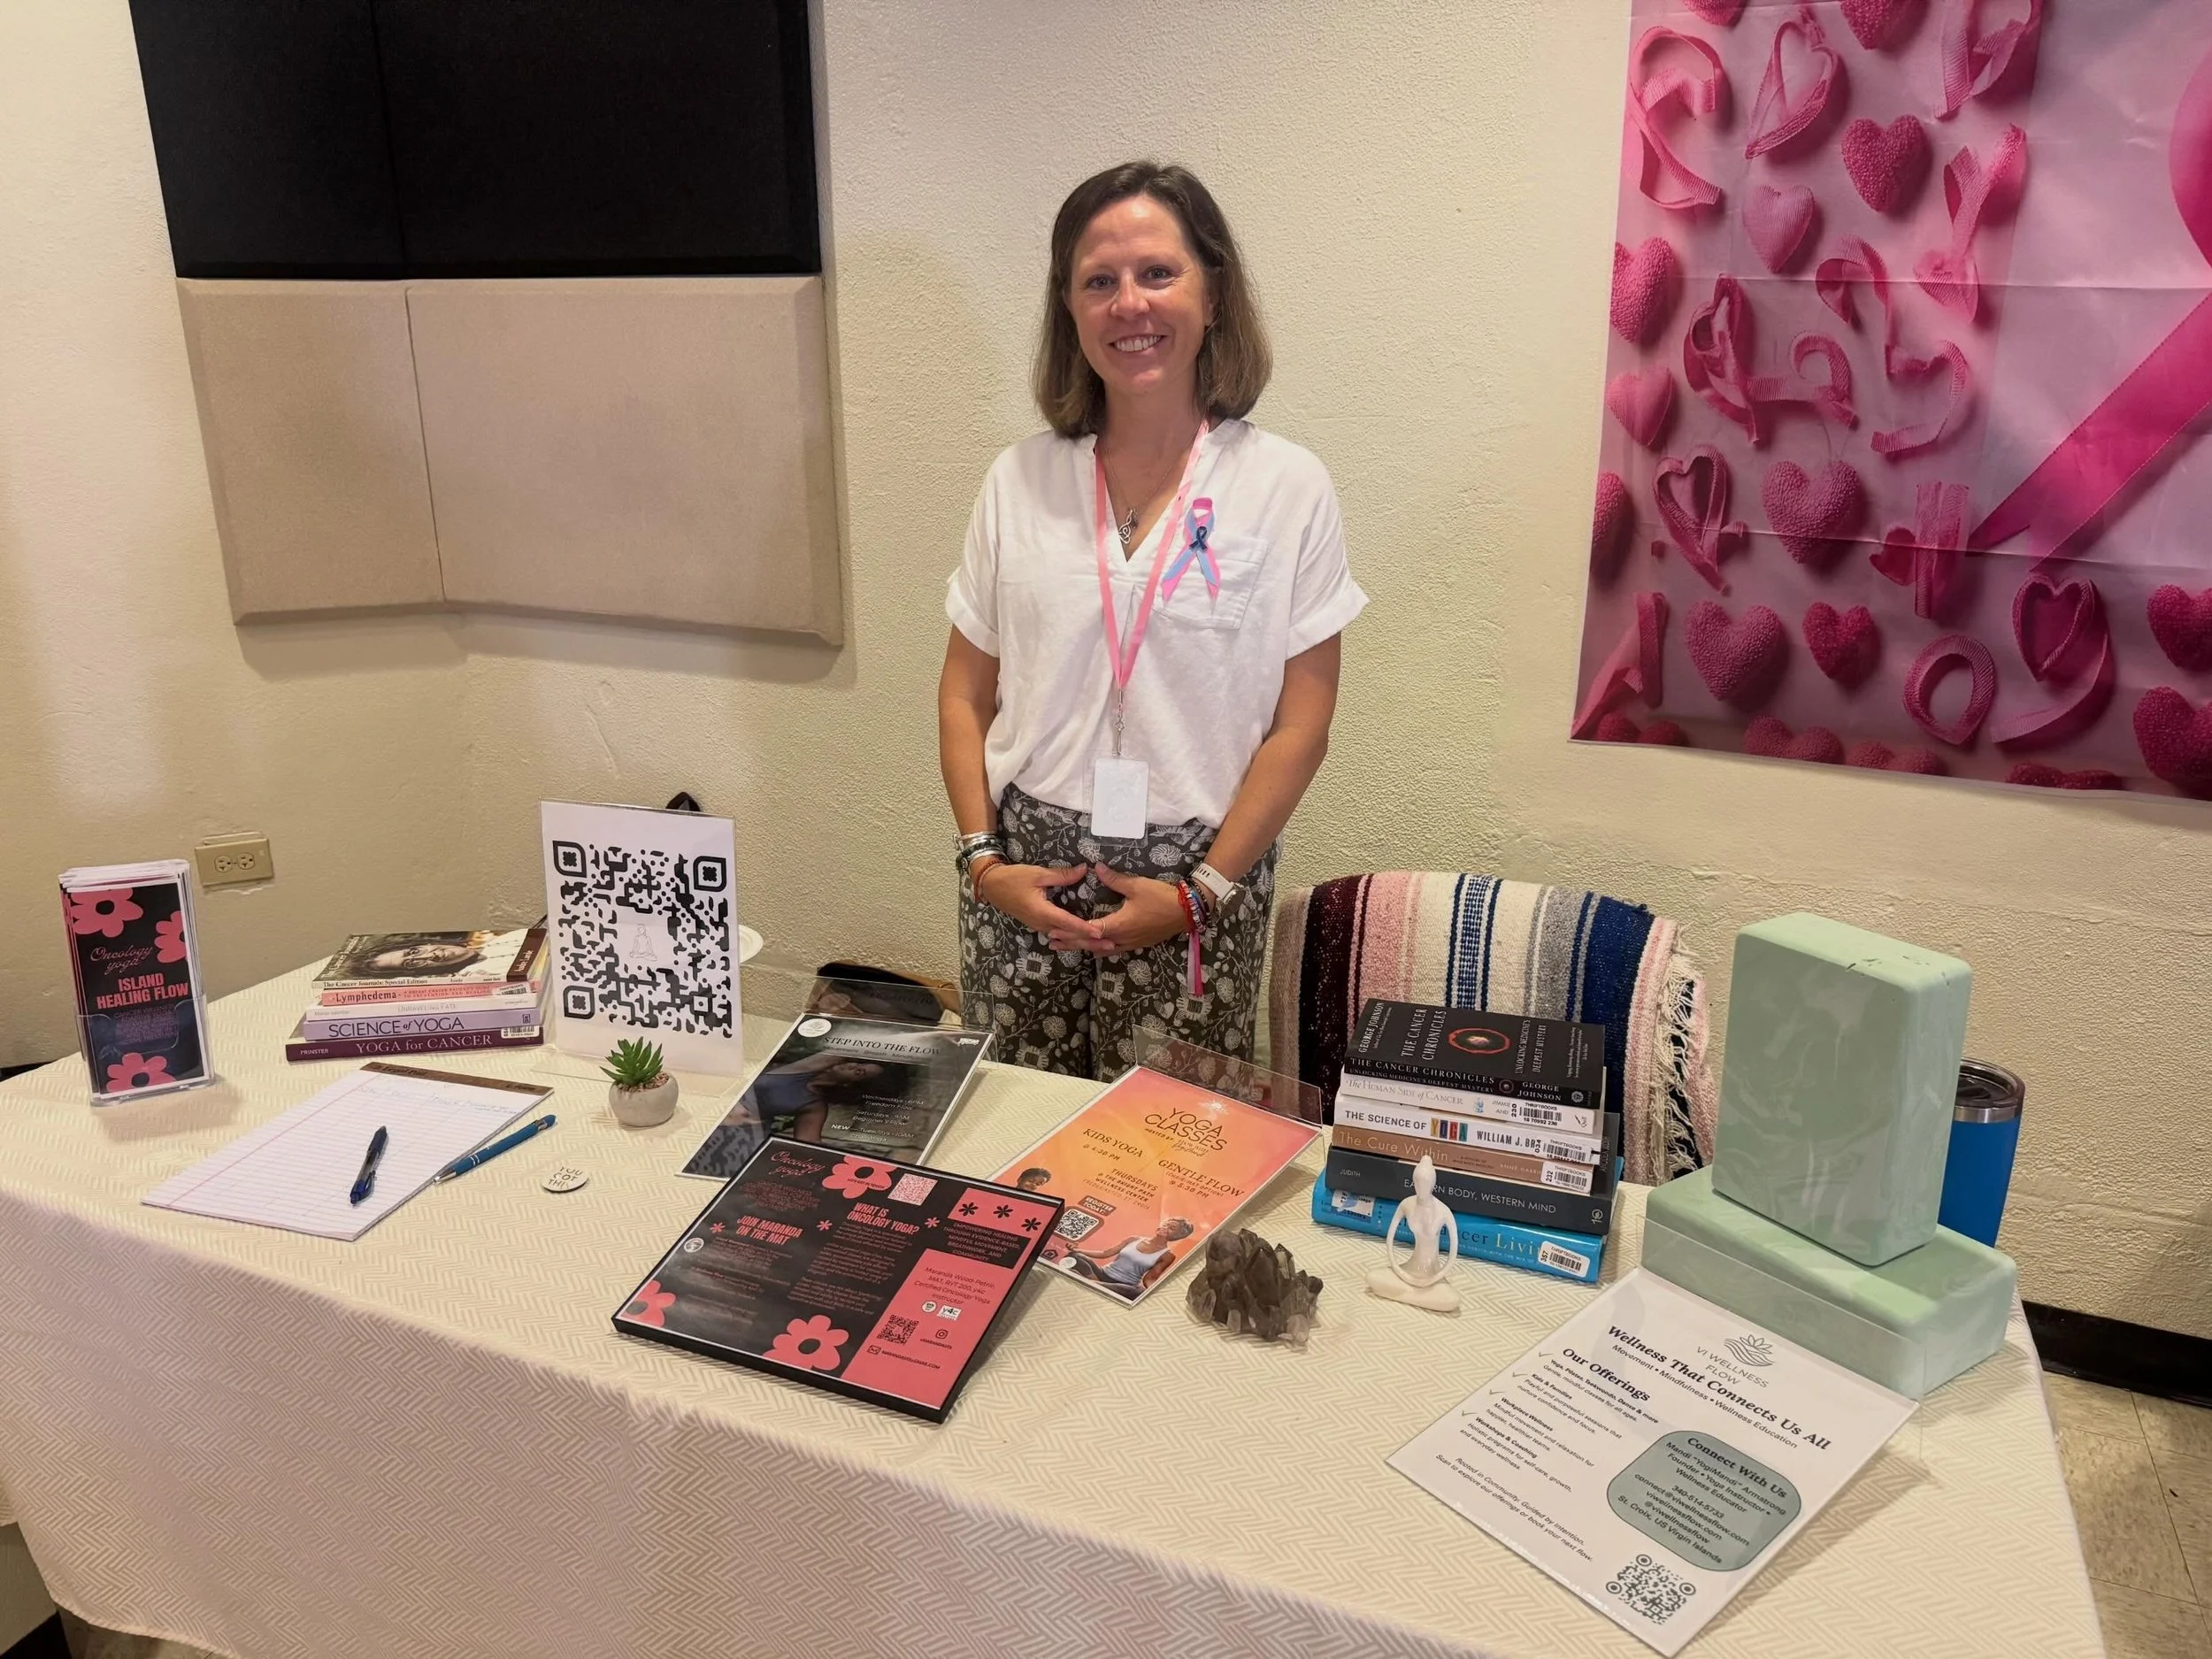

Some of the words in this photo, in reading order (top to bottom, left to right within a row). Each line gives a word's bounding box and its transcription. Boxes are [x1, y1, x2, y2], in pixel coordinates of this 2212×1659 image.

[90, 945, 152, 961] Oncology
[104, 958, 140, 975] yoga
[119, 973, 164, 991] ISLAND
[96, 990, 150, 1009] HEALING
[154, 983, 188, 1000] FLOW
[335, 991, 396, 1003] Lymphedema
[329, 1020, 401, 1037] SCIENCE
[403, 1021, 414, 1031] of
[412, 1017, 465, 1032] YOGA
[1358, 1025, 1375, 1053] GEORGE
[1369, 1002, 1385, 1028] JOHNSON
[1402, 1041, 1417, 1056] THE
[1411, 1009, 1427, 1039] CANCER
[1422, 1010, 1447, 1061] CHRONICLES
[356, 1041, 401, 1054] YOGA
[406, 1040, 423, 1050] for
[427, 1035, 492, 1048] CANCER
[822, 1036, 851, 1045] STEP
[852, 1040, 881, 1048] INTO
[1532, 1047, 1544, 1072] DEEPEST
[1349, 1069, 1387, 1078] UNLOCKING
[1462, 1084, 1494, 1093] MYSTERY
[1376, 1062, 1419, 1073] CANCER
[1423, 1068, 1494, 1084] CHRONICLES
[1517, 1089, 1562, 1101] JOHNSON
[1522, 1082, 1559, 1092] GEORGE
[1145, 1114, 1226, 1150] CLASSES
[1169, 1108, 1222, 1136] YOGA
[1345, 1110, 1364, 1121] THE
[1368, 1115, 1410, 1127] SCIENCE
[1413, 1121, 1427, 1130] OF
[1431, 1118, 1468, 1142] YOGA
[1083, 1128, 1111, 1143] KIDS
[1112, 1140, 1142, 1157] YOGA
[1340, 1132, 1362, 1146] The
[1367, 1137, 1398, 1153] Cure
[1403, 1143, 1448, 1162] Within
[1477, 1130, 1512, 1144] WILLIAM
[1515, 1137, 1523, 1147] J.
[1525, 1139, 1536, 1148] BR
[560, 1166, 583, 1176] YOU
[768, 1163, 811, 1178] yoga
[771, 1151, 825, 1173] Oncology
[1111, 1168, 1158, 1191] THURSDAYS
[1158, 1159, 1206, 1182] GENTLE
[1205, 1178, 1244, 1196] FLOW
[1177, 1182, 1195, 1192] 5:30
[1545, 1171, 1554, 1182] 232
[1095, 1177, 1125, 1192] WELLNESS
[1125, 1190, 1148, 1202] CENTER
[1404, 1179, 1446, 1194] EARN
[1448, 1187, 1478, 1201] BODY,
[1481, 1193, 1525, 1208] WESTERN
[1529, 1202, 1556, 1214] MIND
[853, 1202, 879, 1215] WHAT
[877, 1208, 889, 1217] IS
[1086, 1197, 1113, 1211] REGISTER
[736, 1215, 759, 1226] JOIN
[757, 1220, 802, 1237] MARANDA
[847, 1210, 891, 1227] ONCOLOGY
[890, 1220, 919, 1234] YOGA?
[735, 1225, 751, 1235] ON
[749, 1228, 768, 1240] THE
[765, 1233, 789, 1245] MAT
[1563, 1348, 1588, 1364] Our
[1589, 1363, 1649, 1401] Offerings
[1697, 1346, 1708, 1356] VI
[1709, 1353, 1768, 1387] WELLNESS
[1705, 1364, 1740, 1384] FLOW
[1550, 1359, 1563, 1370] Yoga,
[1564, 1367, 1583, 1381] Pilates,
[1585, 1379, 1616, 1400] Taekwondo,
[1617, 1398, 1636, 1410] Dance
[1642, 1413, 1658, 1423] more
[1609, 1325, 1667, 1362] Wellness
[1670, 1359, 1705, 1382] That
[1707, 1380, 1777, 1421] Connects
[1780, 1418, 1801, 1434] Us
[1802, 1433, 1831, 1449] All
[1612, 1344, 1654, 1370] Movement
[1659, 1370, 1708, 1400] Mindfulness
[1715, 1400, 1752, 1424] Wellness
[1753, 1421, 1797, 1448] Education
[1666, 1441, 1692, 1458] Mandi
[1741, 1486, 1786, 1515] Armstrong
[1687, 1438, 1735, 1468] Connect
[1739, 1465, 1767, 1486] With
[1770, 1484, 1786, 1497] Us
[1667, 1453, 1700, 1473] Founder
[1706, 1474, 1724, 1489] Yoga
[1725, 1486, 1765, 1511] Instructor
[1676, 1467, 1709, 1491] Wellness
[1710, 1488, 1747, 1512] Educator
[1634, 1474, 1748, 1545] connect@viwellnessflow.com
[1671, 1485, 1724, 1518] 340-514-5733
[1645, 1502, 1709, 1543] @viwellnessflow
[1646, 1491, 1721, 1540] viwellnessflow.com
[1617, 1495, 1627, 1504] St.
[1630, 1502, 1651, 1520] Croix,
[1654, 1517, 1668, 1528] US
[1668, 1525, 1691, 1544] Virgin
[1692, 1541, 1722, 1563] Islands
